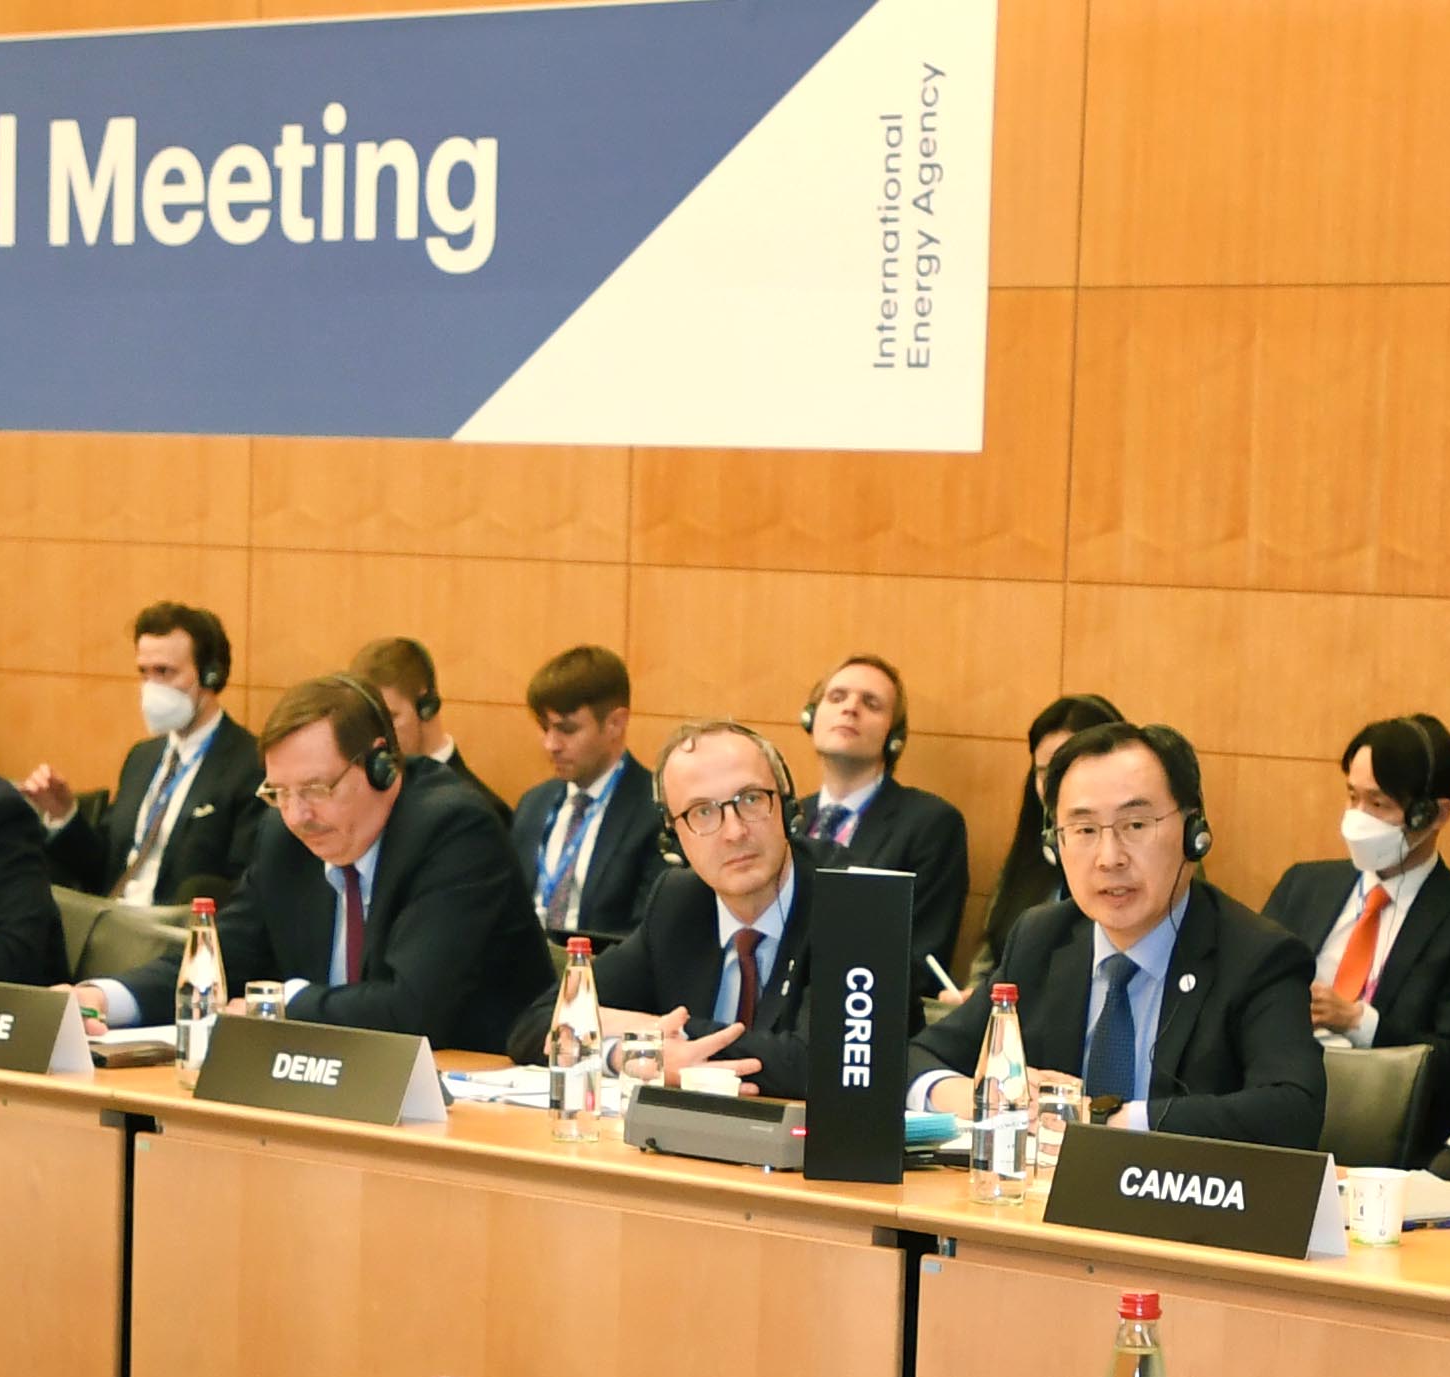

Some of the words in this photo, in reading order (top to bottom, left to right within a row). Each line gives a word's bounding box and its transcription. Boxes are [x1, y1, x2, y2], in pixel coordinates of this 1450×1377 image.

[48, 101, 499, 274] Meeting
[911, 62, 947, 217] Agency
[873, 113, 904, 369] International
[906, 229, 942, 369] Energy
[271, 1052, 343, 1086] DEME
[842, 966, 875, 1088] COREE
[1119, 1166, 1245, 1211] CANADA
